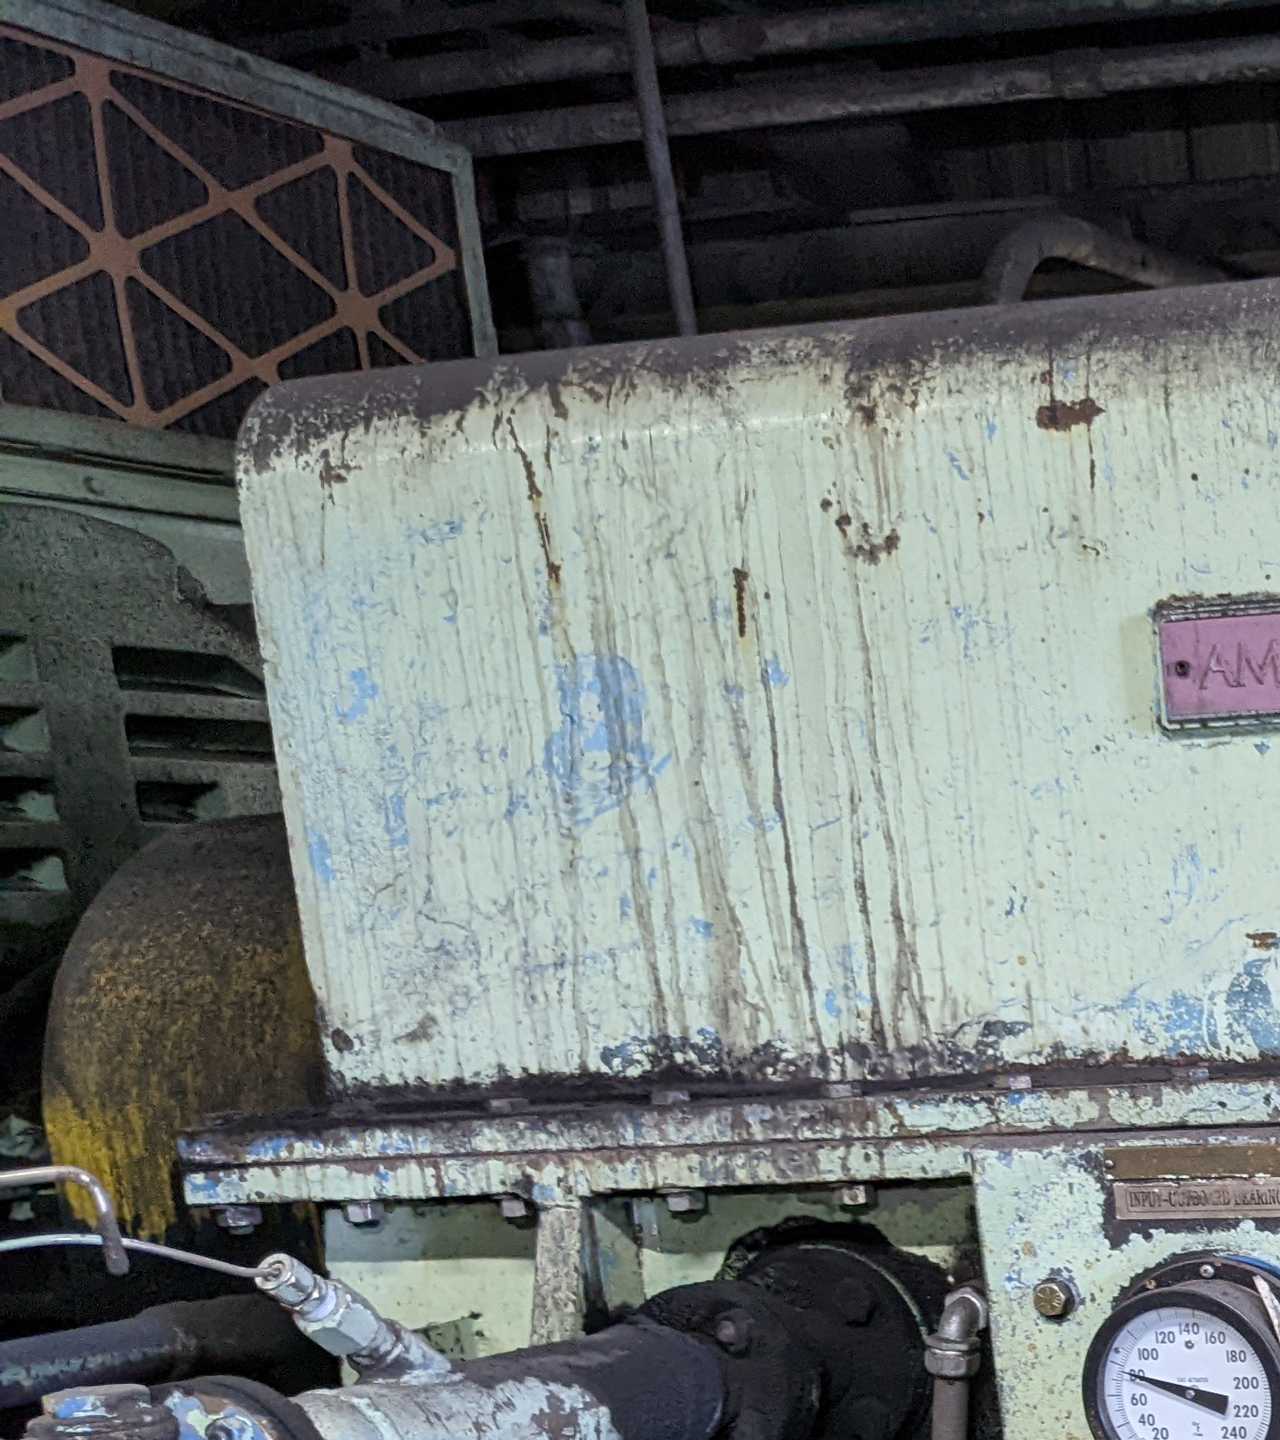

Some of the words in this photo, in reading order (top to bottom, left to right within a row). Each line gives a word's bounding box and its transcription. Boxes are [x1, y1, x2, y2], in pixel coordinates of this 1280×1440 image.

[1178, 1322, 1199, 1335] 140
[1155, 1331, 1176, 1344] 120
[1205, 1331, 1226, 1344] 160
[1138, 1348, 1159, 1360] 100
[1226, 1350, 1247, 1363] 180
[1233, 1377, 1259, 1390] 200
[1130, 1393, 1147, 1406] 60
[1233, 1405, 1259, 1418] 220
[1138, 1414, 1155, 1426] 40
[1152, 1428, 1169, 1440] 20
[1221, 1426, 1247, 1439] 240
